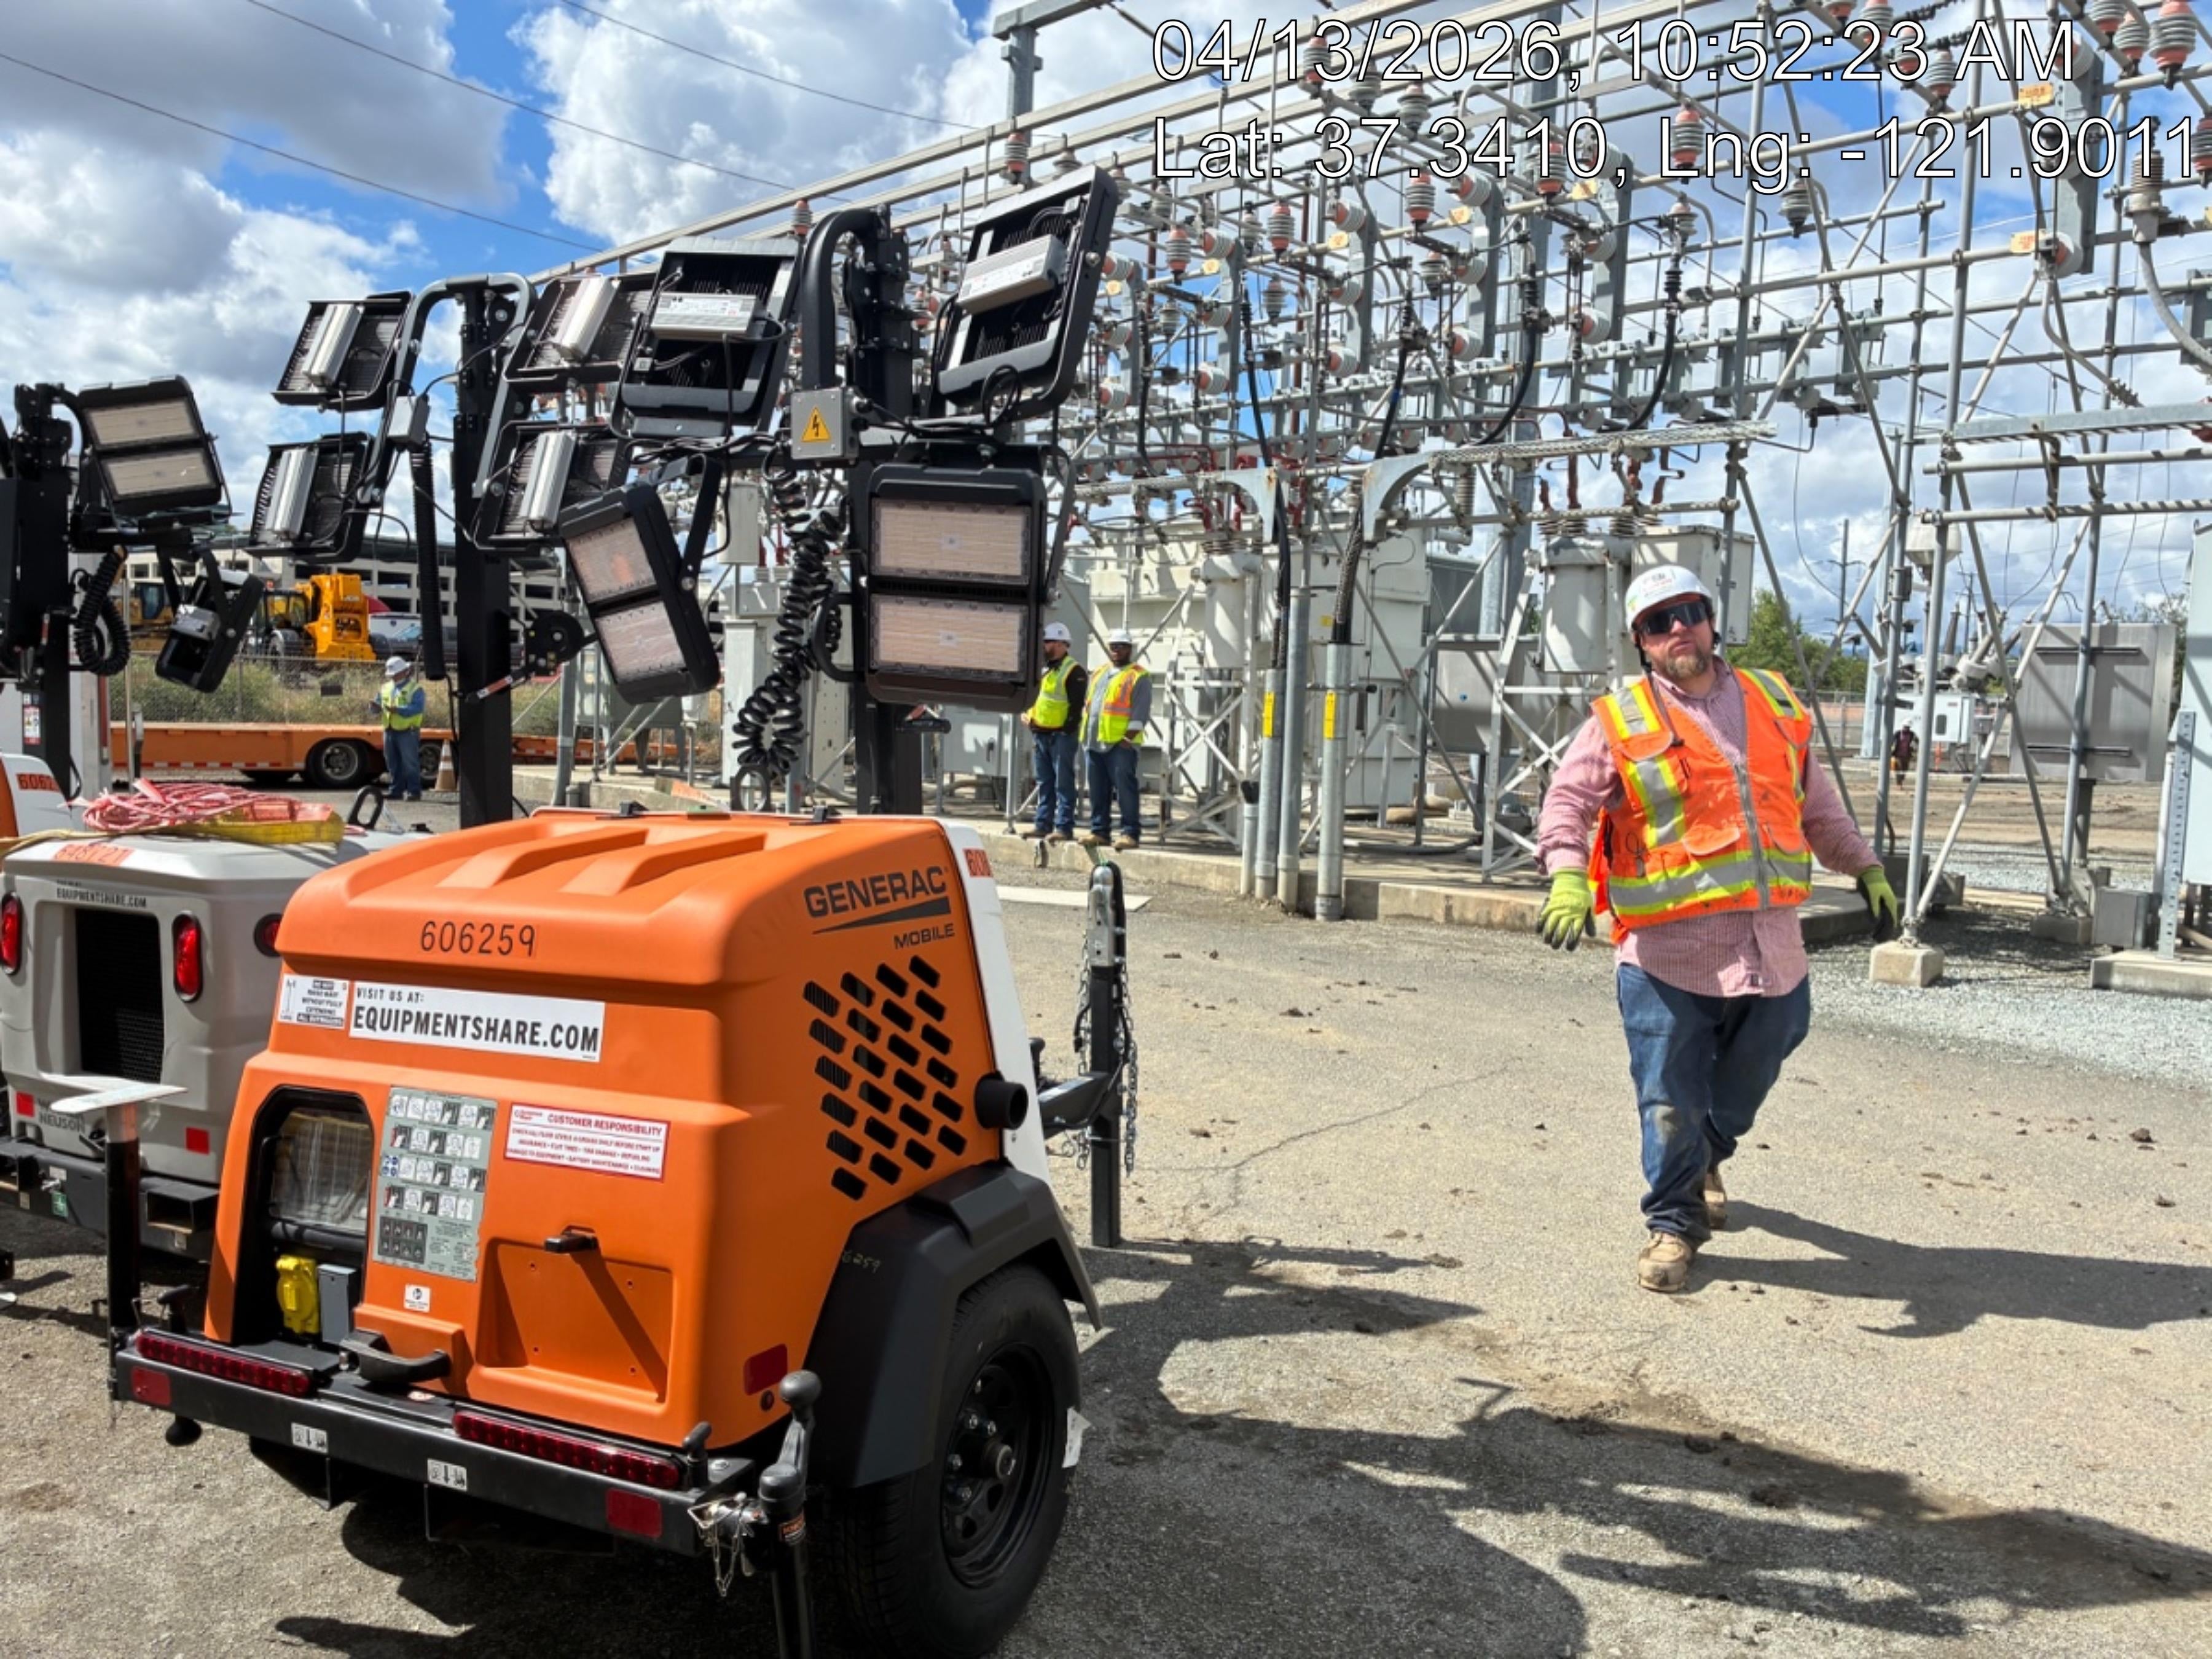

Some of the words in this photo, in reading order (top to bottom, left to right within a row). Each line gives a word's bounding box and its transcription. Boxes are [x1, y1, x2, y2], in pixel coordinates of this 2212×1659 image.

[804, 866, 947, 918] GENERAC
[421, 920, 535, 957] 606259
[893, 923, 955, 949] MOBILE
[357, 987, 384, 1000] VISIT
[389, 990, 402, 1002] US
[407, 992, 425, 1003] AT:
[353, 1005, 600, 1053] EQUIPMENTSHARE.COM
[547, 1113, 592, 1128] CUSTOMER
[594, 1119, 662, 1136] RESPONSIBILITY
